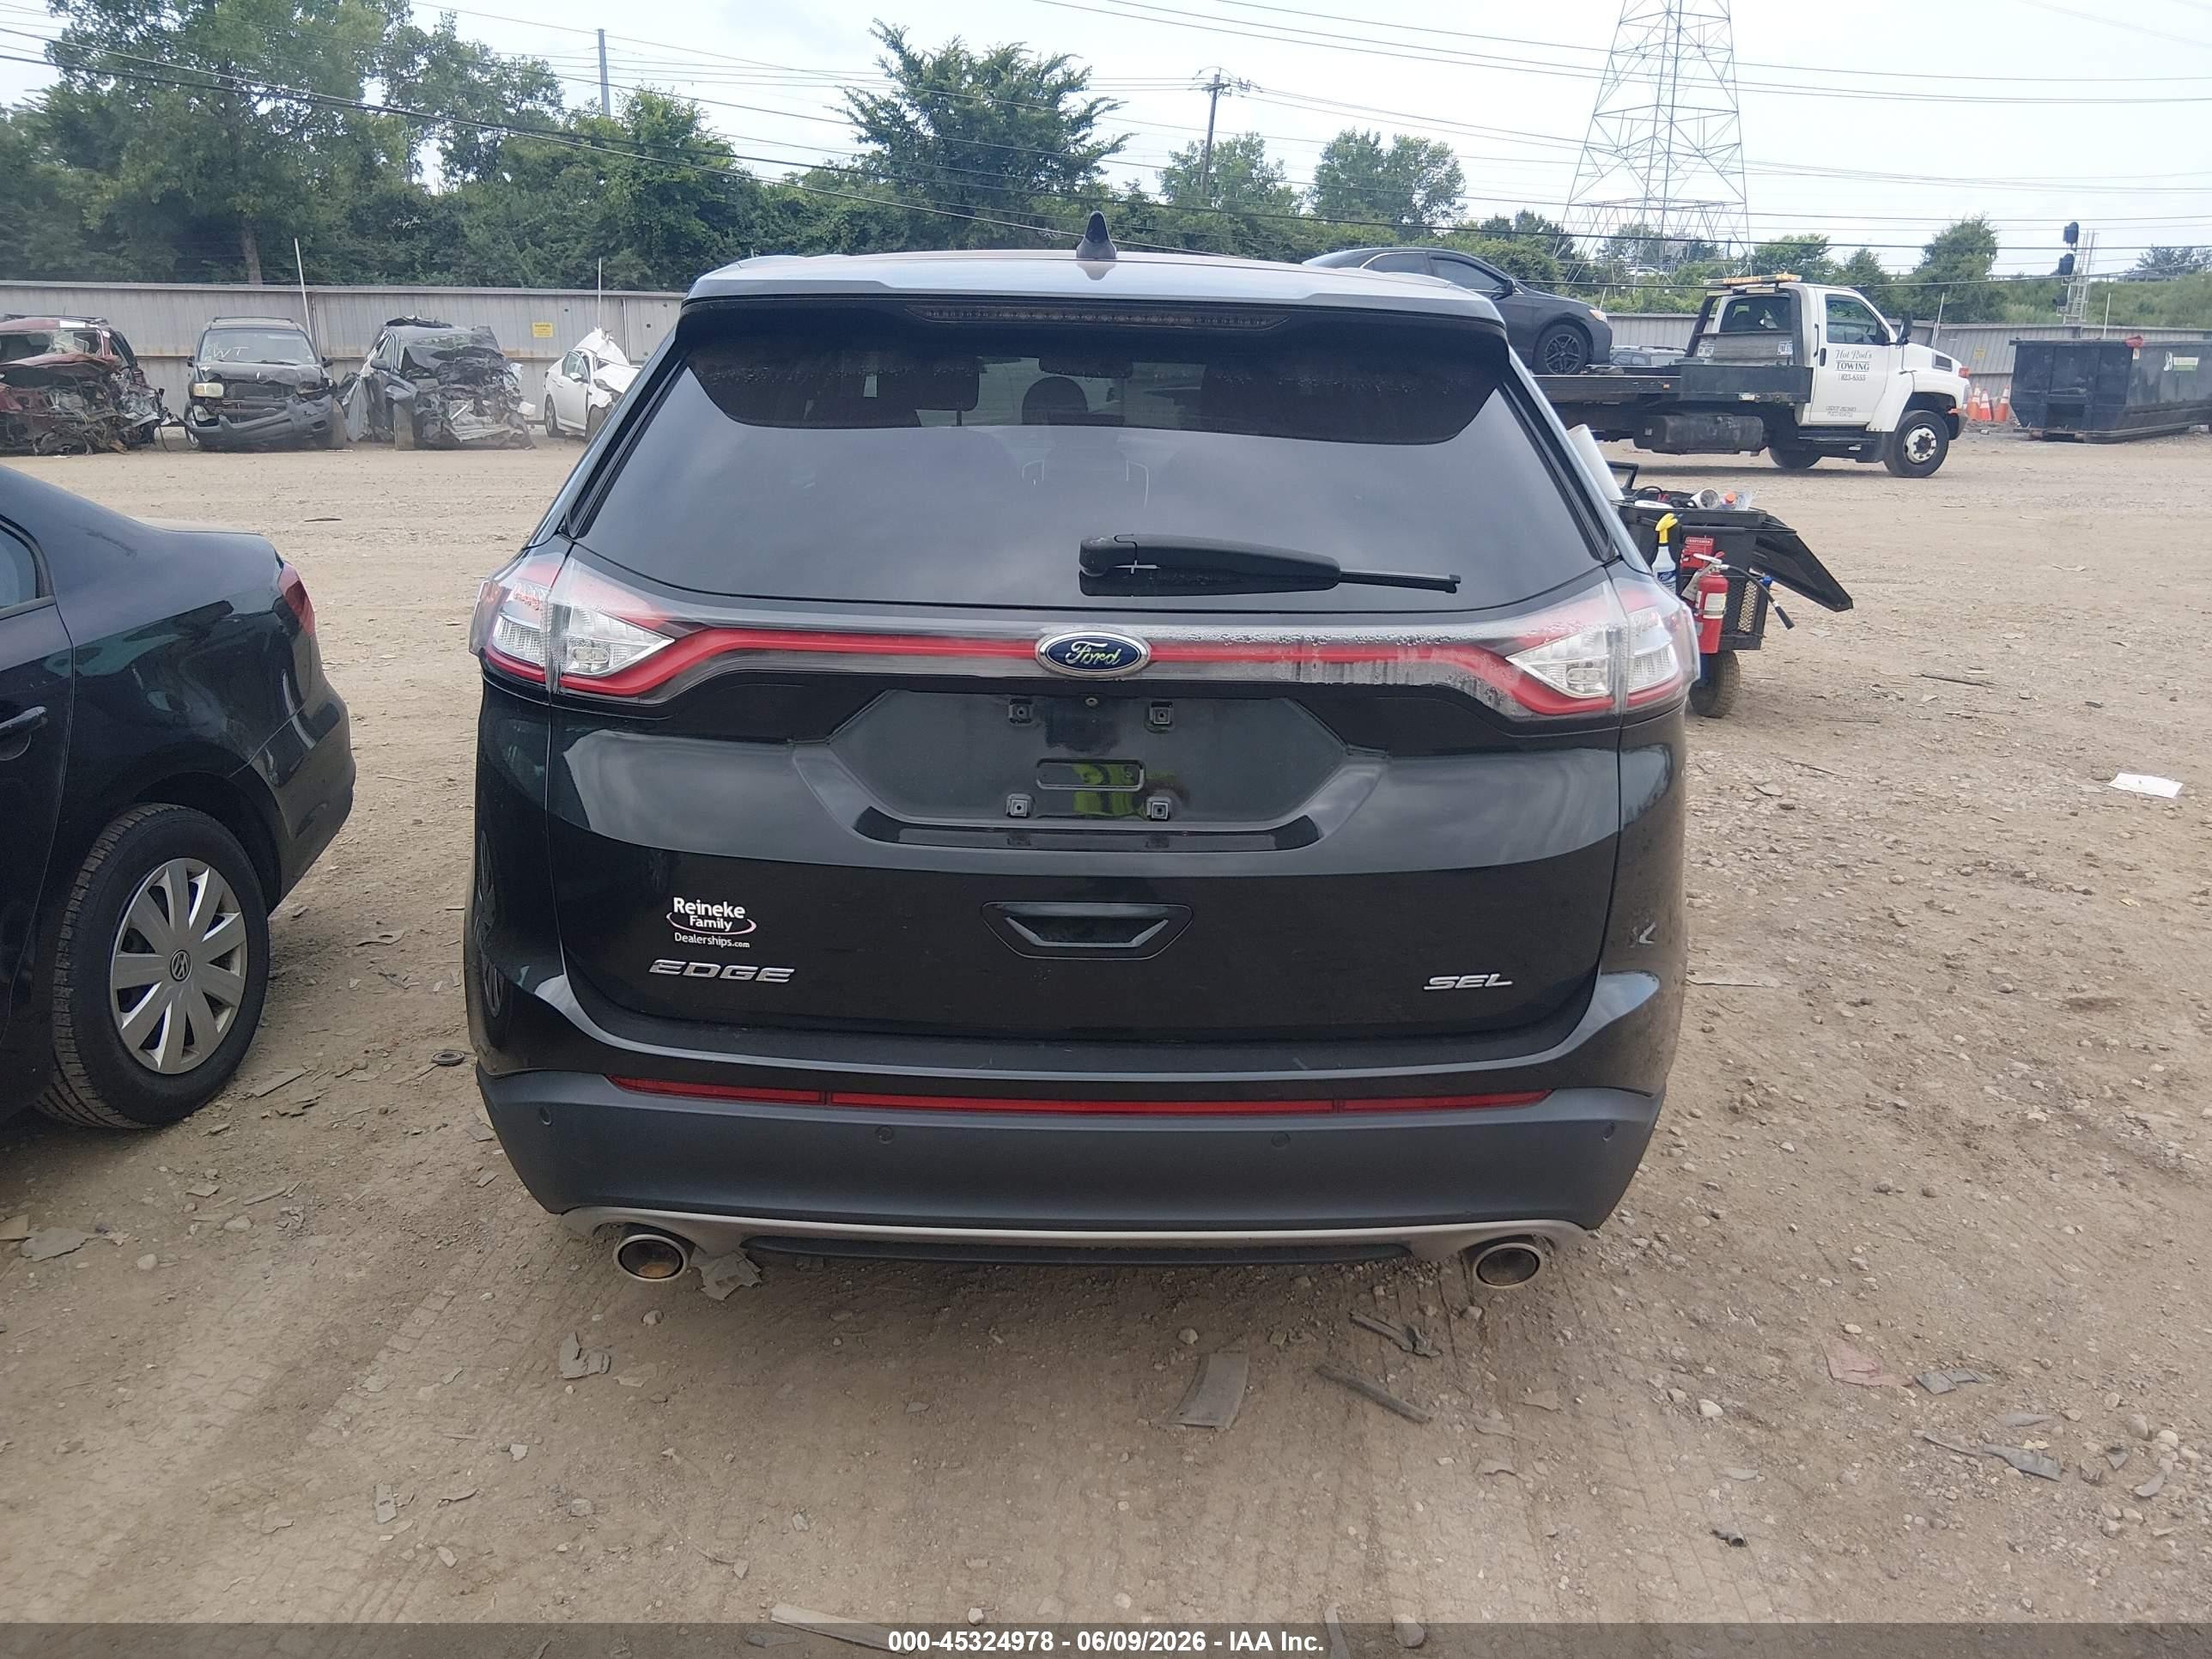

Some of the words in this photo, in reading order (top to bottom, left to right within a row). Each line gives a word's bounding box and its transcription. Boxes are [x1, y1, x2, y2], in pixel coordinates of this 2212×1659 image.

[1835, 349, 1850, 359] Hot
[1836, 362, 1869, 371] TOWING
[1065, 641, 1121, 665] Ford
[673, 896, 745, 919] Reineke
[690, 915, 732, 932] Family
[674, 932, 750, 948] Dealerships.com
[648, 958, 795, 983] EDGE
[1424, 973, 1513, 990] SEL
